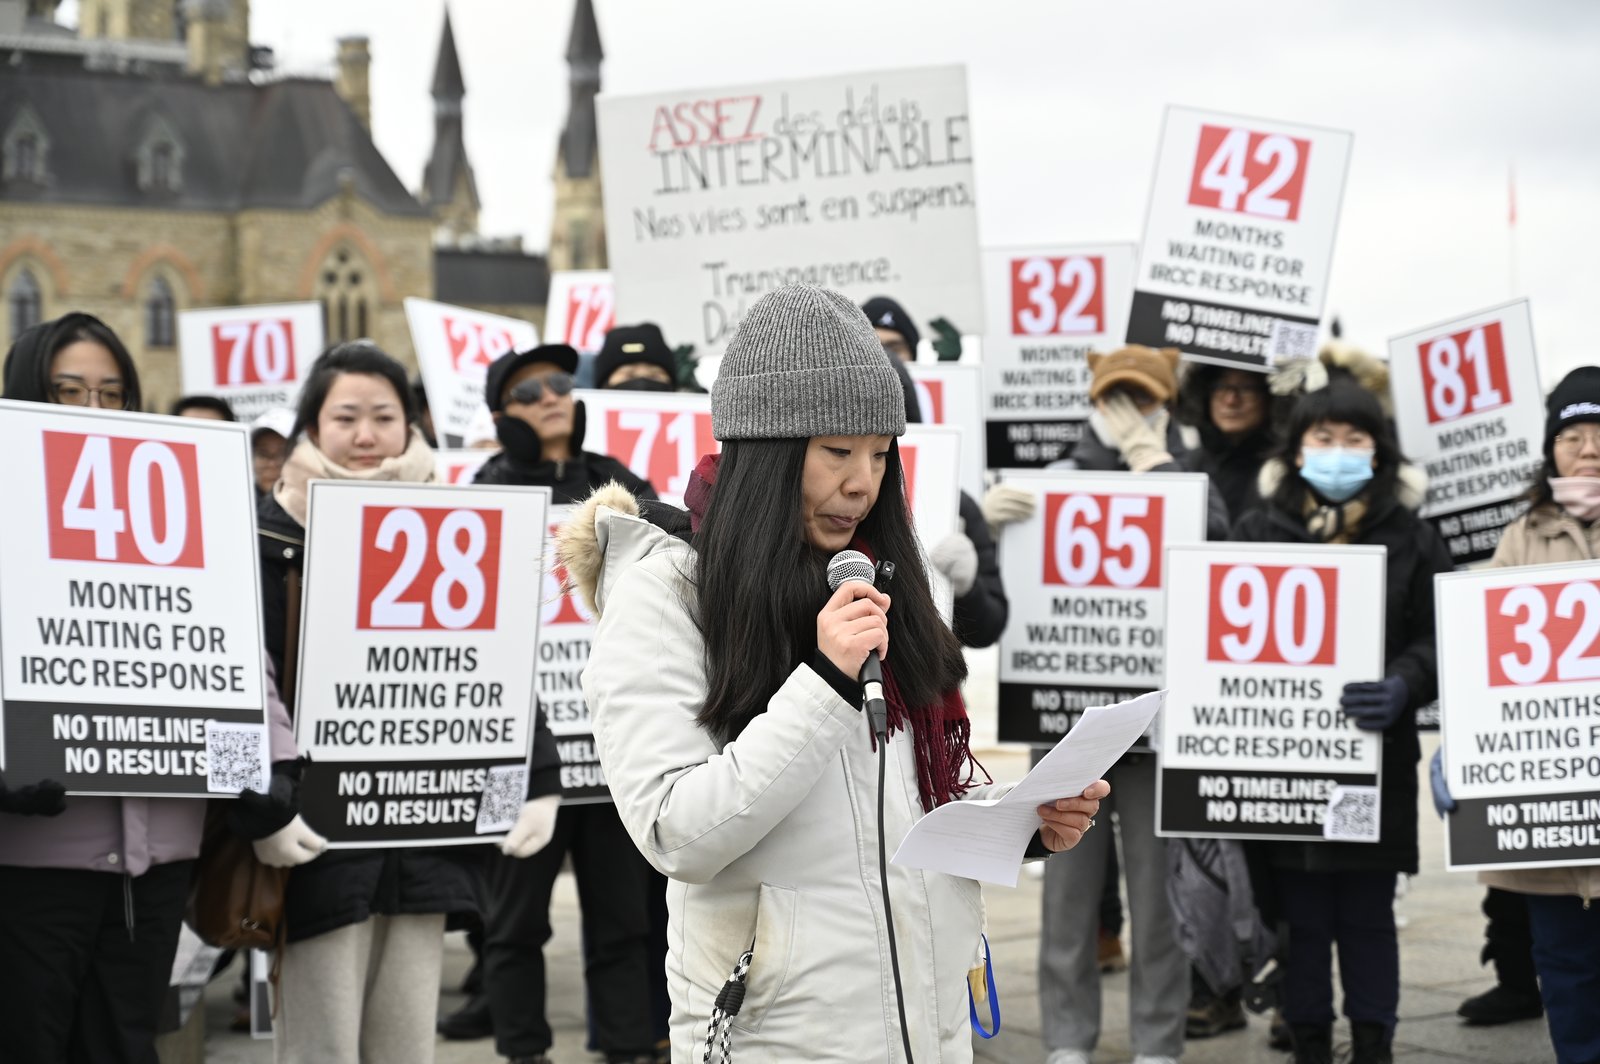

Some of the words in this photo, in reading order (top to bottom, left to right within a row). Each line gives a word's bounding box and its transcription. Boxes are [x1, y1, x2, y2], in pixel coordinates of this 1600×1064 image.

[648, 95, 766, 151] ASSEZ
[773, 91, 823, 135] des
[1199, 128, 1299, 219] 42
[632, 206, 686, 241] Nos
[688, 206, 748, 234] vies
[754, 193, 811, 231] sont
[820, 194, 859, 221] en
[1194, 219, 1285, 249] MONTHS
[1168, 239, 1256, 270] WAITING
[1262, 254, 1305, 278] FOR
[1017, 256, 1098, 335] 32
[1149, 263, 1197, 287] IRCC
[1199, 271, 1312, 305] RESPONSE
[1161, 299, 1191, 323] NO
[1164, 322, 1195, 345] NO
[218, 319, 289, 384] 70
[1428, 327, 1503, 421] 81
[1438, 417, 1507, 450] MONTHS
[617, 409, 698, 494] 71
[1425, 447, 1493, 478] WAITING
[1496, 437, 1529, 460] FOR
[62, 435, 188, 566] 40
[1054, 493, 1152, 589] 65
[370, 507, 488, 630] 28
[69, 580, 193, 613] MONTHS
[1051, 597, 1147, 620] MONTHS
[1219, 564, 1327, 666] 90
[37, 617, 162, 651] WAITING
[172, 625, 226, 653] FOR
[1026, 624, 1121, 646] WAITING
[1128, 626, 1163, 648] FO
[1499, 579, 1600, 685] 32
[21, 656, 86, 686] IRCC
[94, 659, 246, 693] RESPONSE
[366, 647, 478, 673] MONTHS
[1012, 652, 1061, 672] IRCC
[335, 683, 447, 709] WAITING
[454, 683, 504, 708] FOR
[1031, 689, 1061, 711] NO
[1219, 677, 1323, 701] MONTHS
[53, 714, 89, 741] NO
[92, 715, 214, 744] TIMELINE
[314, 719, 375, 746] IRCC
[382, 717, 516, 745] RESPONSE
[1039, 712, 1069, 734] NO
[1192, 705, 1295, 729] WAITING
[1302, 709, 1349, 732] FOR
[1177, 735, 1229, 757] IRCC
[1234, 736, 1364, 761] RESPONSE
[1476, 726, 1580, 754] WAITING
[65, 747, 101, 774] NO
[1462, 761, 1516, 785] IRCC
[338, 772, 371, 796] NO
[375, 768, 487, 796] TIMELINES
[1198, 775, 1230, 798] NO
[346, 801, 379, 826] NO
[384, 798, 477, 825] RESULTS
[1206, 800, 1238, 823] NO
[1487, 804, 1518, 826] NO
[1498, 827, 1529, 851] NO
